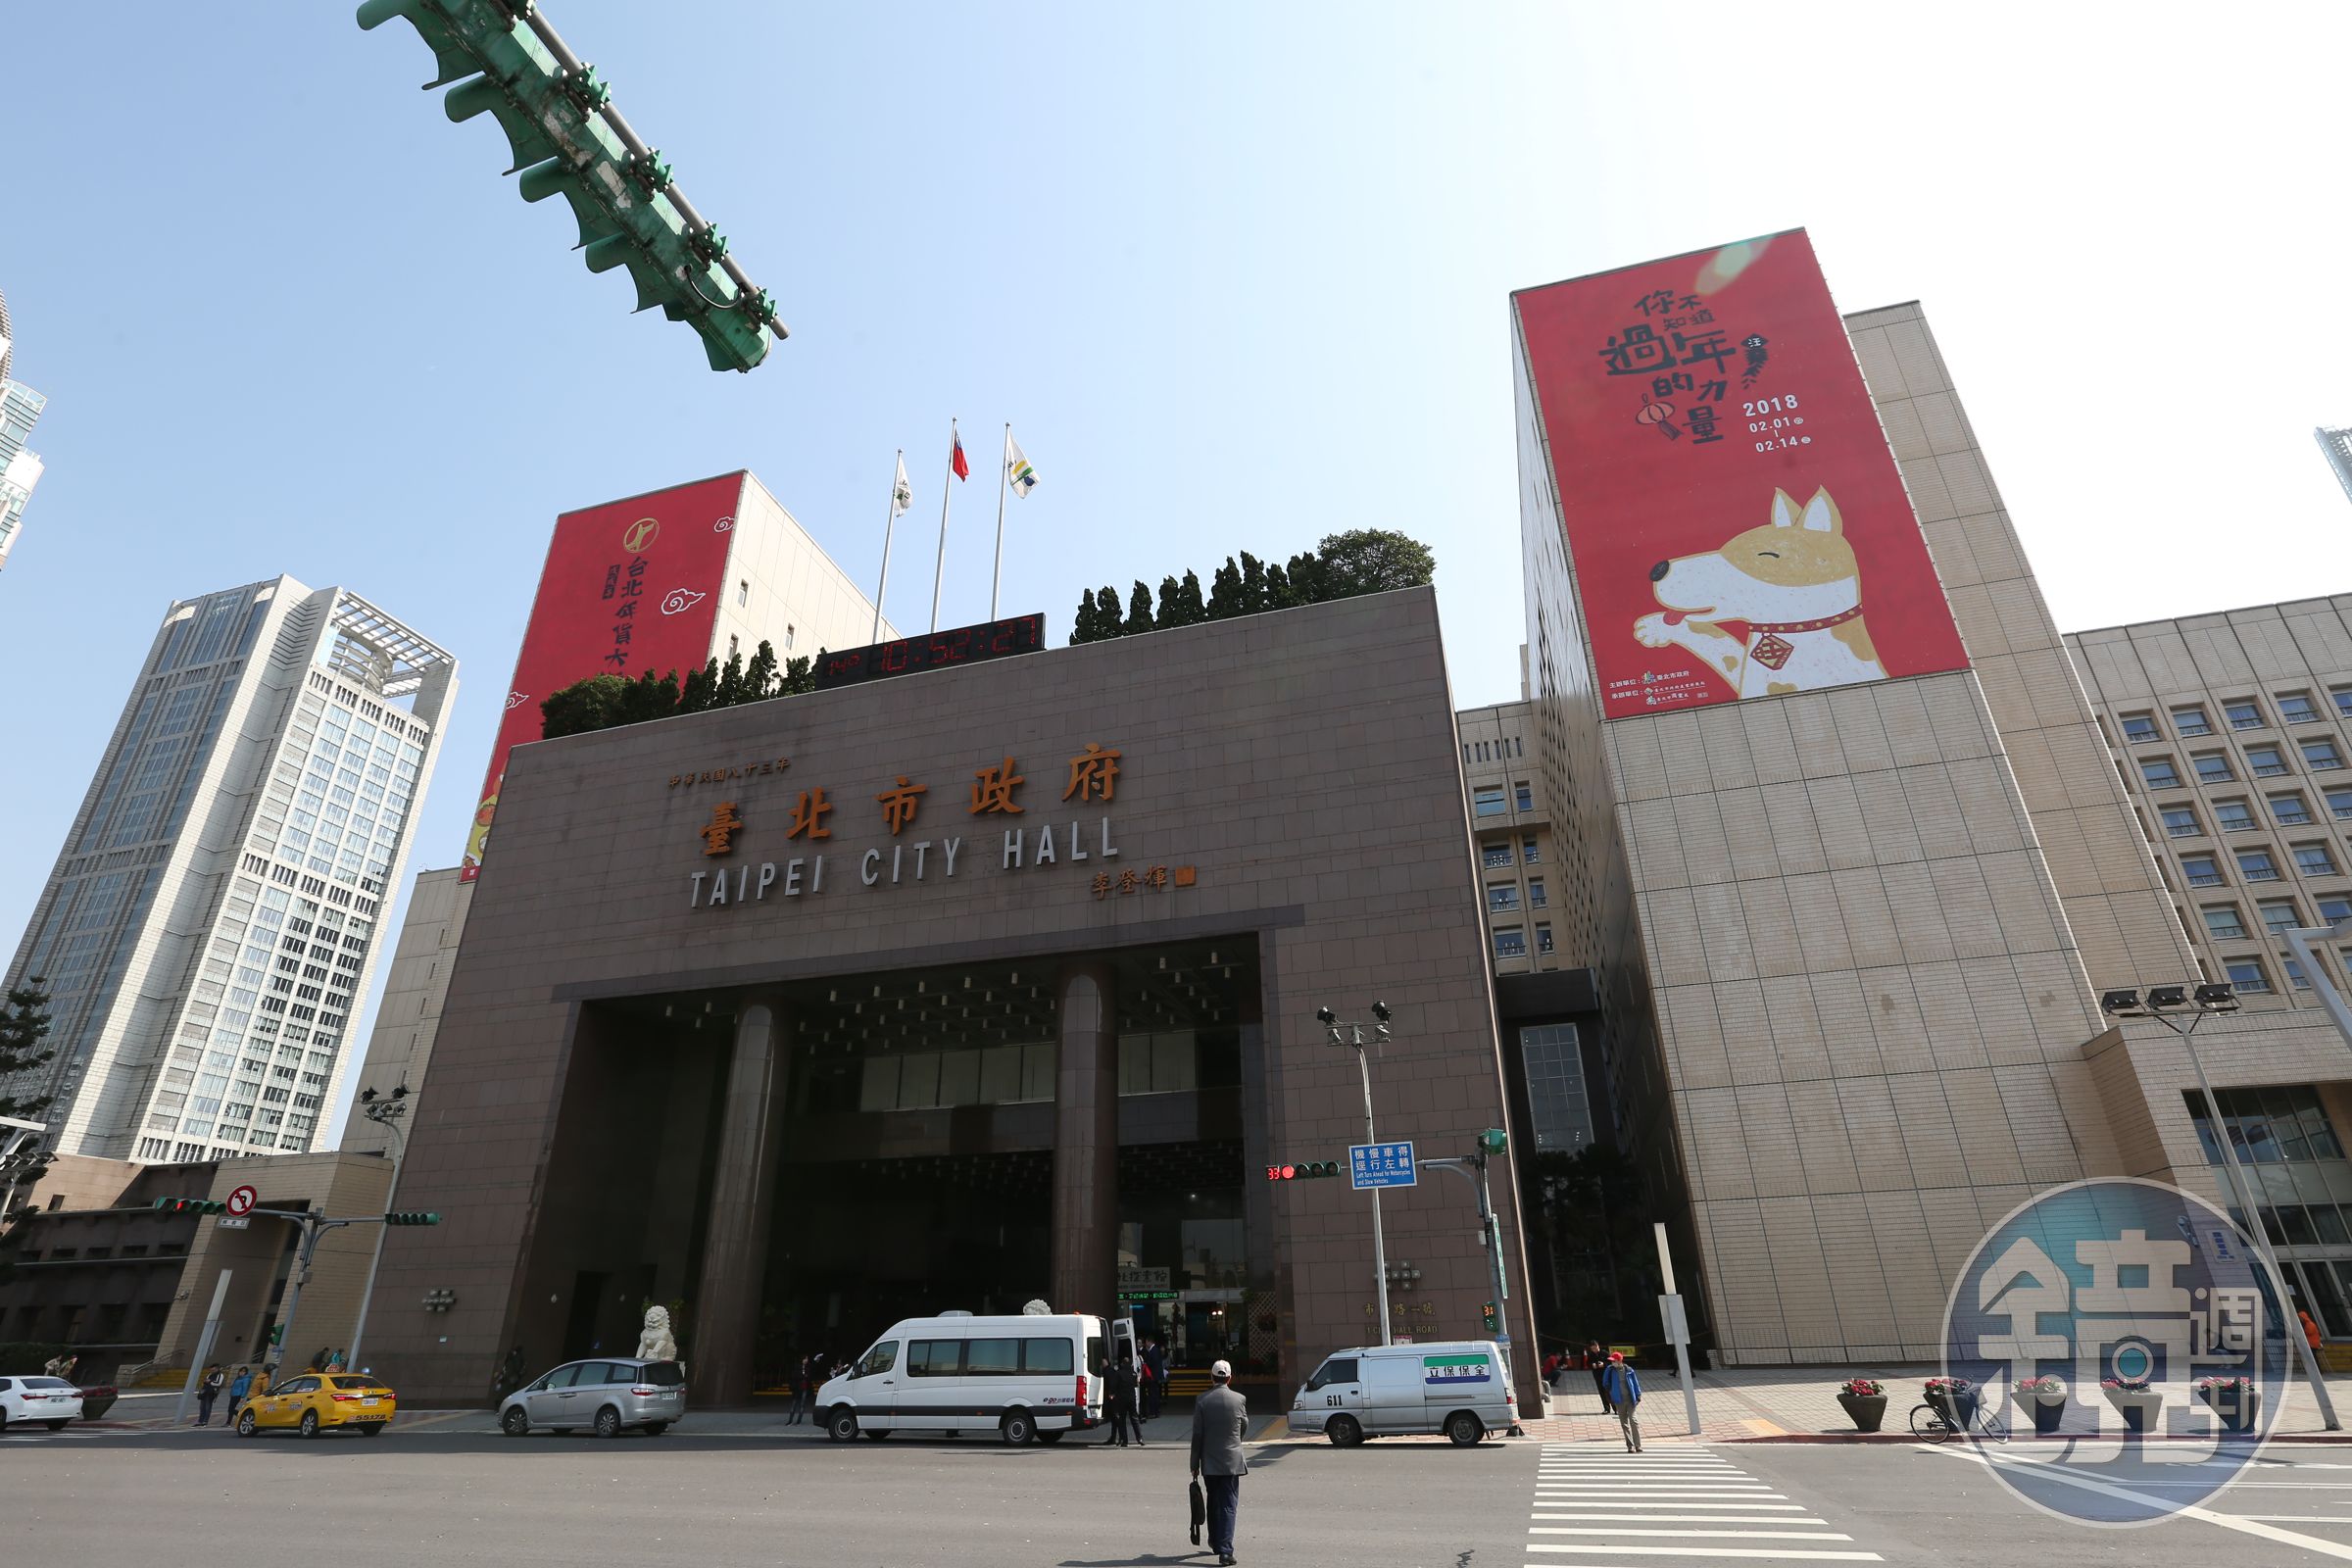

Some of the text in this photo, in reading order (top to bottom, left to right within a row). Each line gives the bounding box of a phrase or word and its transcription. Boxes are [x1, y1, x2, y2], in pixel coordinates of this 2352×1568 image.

[1742, 394, 1798, 416] 2018
[1749, 416, 1790, 433] 02.01
[1755, 436, 1798, 452] 02.14
[604, 557, 649, 676] 台北年貨大
[668, 757, 791, 790] 中華民國八十三年
[699, 743, 1122, 857] 臺北市政府
[690, 816, 1119, 908] TAIPEI CITY HALL
[1091, 864, 1168, 901] 李登輝
[1354, 1146, 1408, 1159] 機慢車得
[1268, 1166, 1280, 1180] 33
[1364, 1302, 1436, 1315] 市路一號
[1484, 1305, 1494, 1316] 31
[1429, 1364, 1487, 1378] 立保保全
[1327, 1394, 1343, 1406] 611
